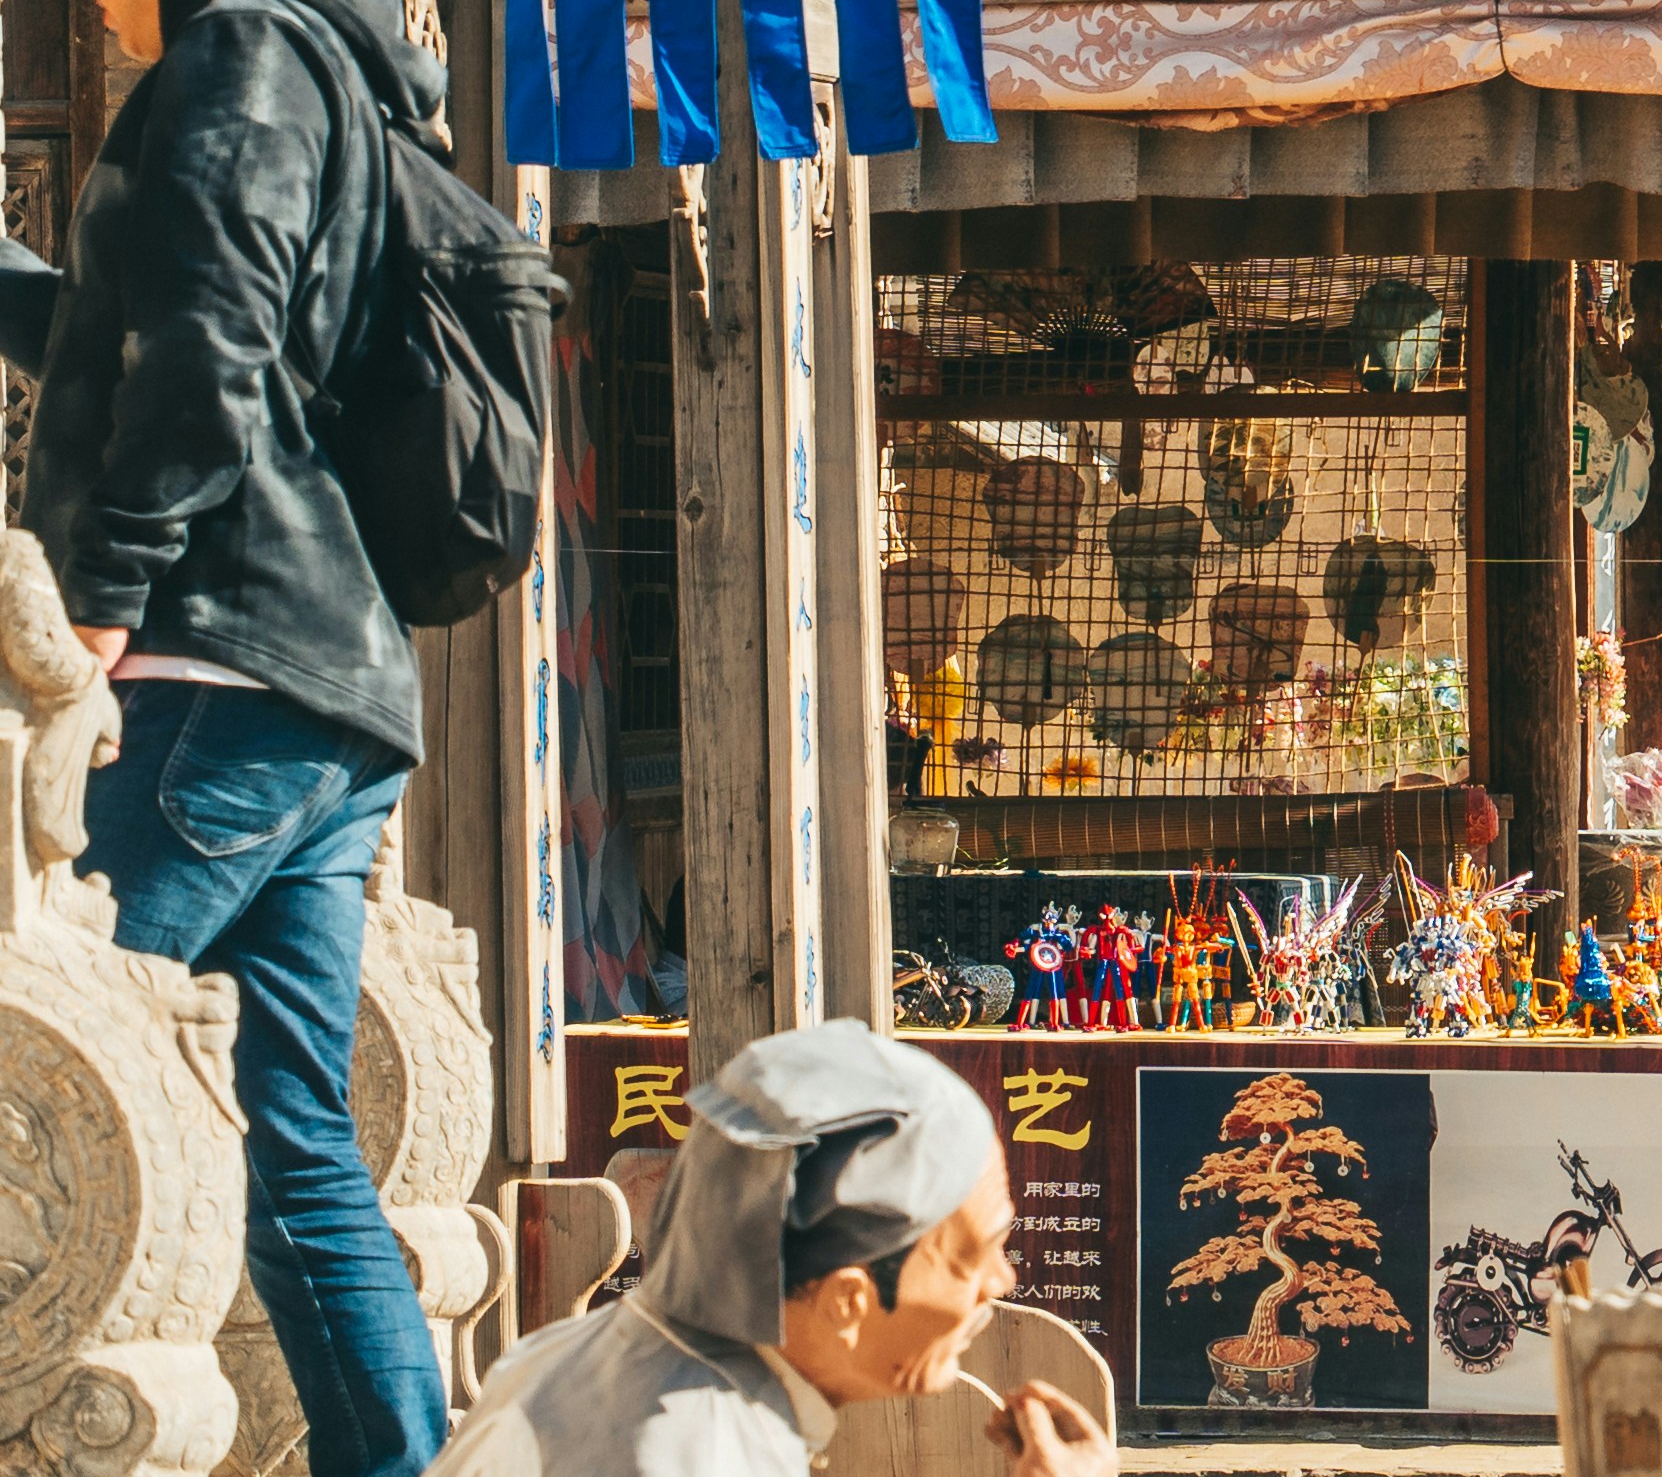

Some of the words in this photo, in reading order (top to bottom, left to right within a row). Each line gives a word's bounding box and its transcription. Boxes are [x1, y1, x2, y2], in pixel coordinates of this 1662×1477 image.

[610, 1065, 691, 1141] 民
[1003, 1067, 1091, 1151] 艺
[1024, 1181, 1100, 1198] 用家里的
